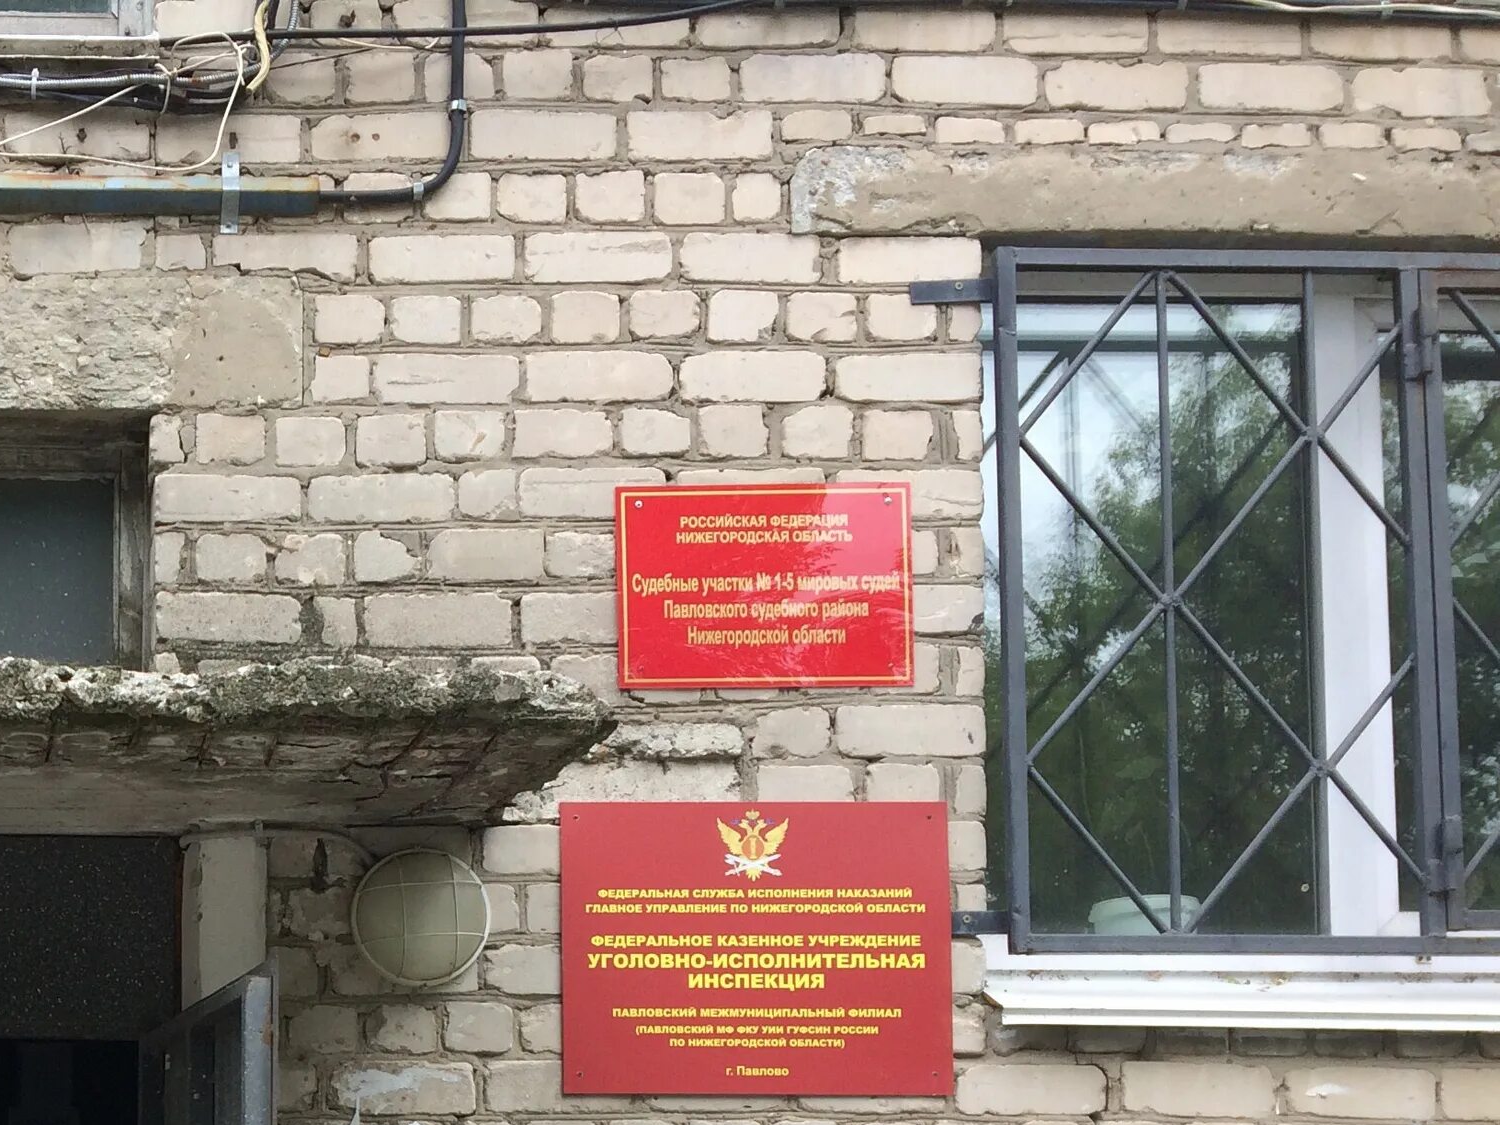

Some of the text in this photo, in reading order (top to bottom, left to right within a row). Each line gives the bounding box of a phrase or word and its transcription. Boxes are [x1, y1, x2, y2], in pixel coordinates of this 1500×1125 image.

[680, 513, 849, 528] РОССИЙСКАЯ ФЕДЕРАЦИЯ
[676, 529, 853, 545] НИЖЕГОРОДСКАЯ ОБЛАСТЬ
[632, 571, 901, 597] Судебные участки № 1-5 мировых судей
[663, 599, 870, 622] Павловского судебного района
[687, 625, 846, 648] Нижегородской области
[597, 886, 913, 899] ФЕДЕРАЛЬНАЯ СЛУЖБА ИСПОЛНЕНИЯ НАКАЗАНИЙ
[585, 902, 926, 915] ГЛАВНОЕ УПРАВЛЕНИЕ ПО НИЖЕГОРОДСКОЙ ОБЛАСТИ
[590, 935, 922, 948] ФЕДЕРАЛЬНОЕ КАЗЕННОЕ УЧРЕЖДЕНИЕ
[587, 953, 926, 969] УГОЛОВНО-ИСПОЛНИТЕЛЬНАЯ
[688, 974, 825, 991] ИНСПЕКЦИЯ
[612, 1007, 902, 1019] ПАВЛОВСКИЙ МЕЖМУНИЦИПАЛЬНЫЙ ФИЛИАЛ
[635, 1024, 714, 1036] (ПАВЛОВСКИЙ
[716, 1026, 735, 1035] МФ
[737, 1026, 760, 1035] ФКУ
[787, 1026, 831, 1035] ГУФСИН
[834, 1026, 879, 1034] РОССИИ
[669, 1037, 846, 1049] ПО НИЖЕГОРОДСКОЙ ОБЛАСТИ)
[725, 1066, 790, 1077] г. Павлово
